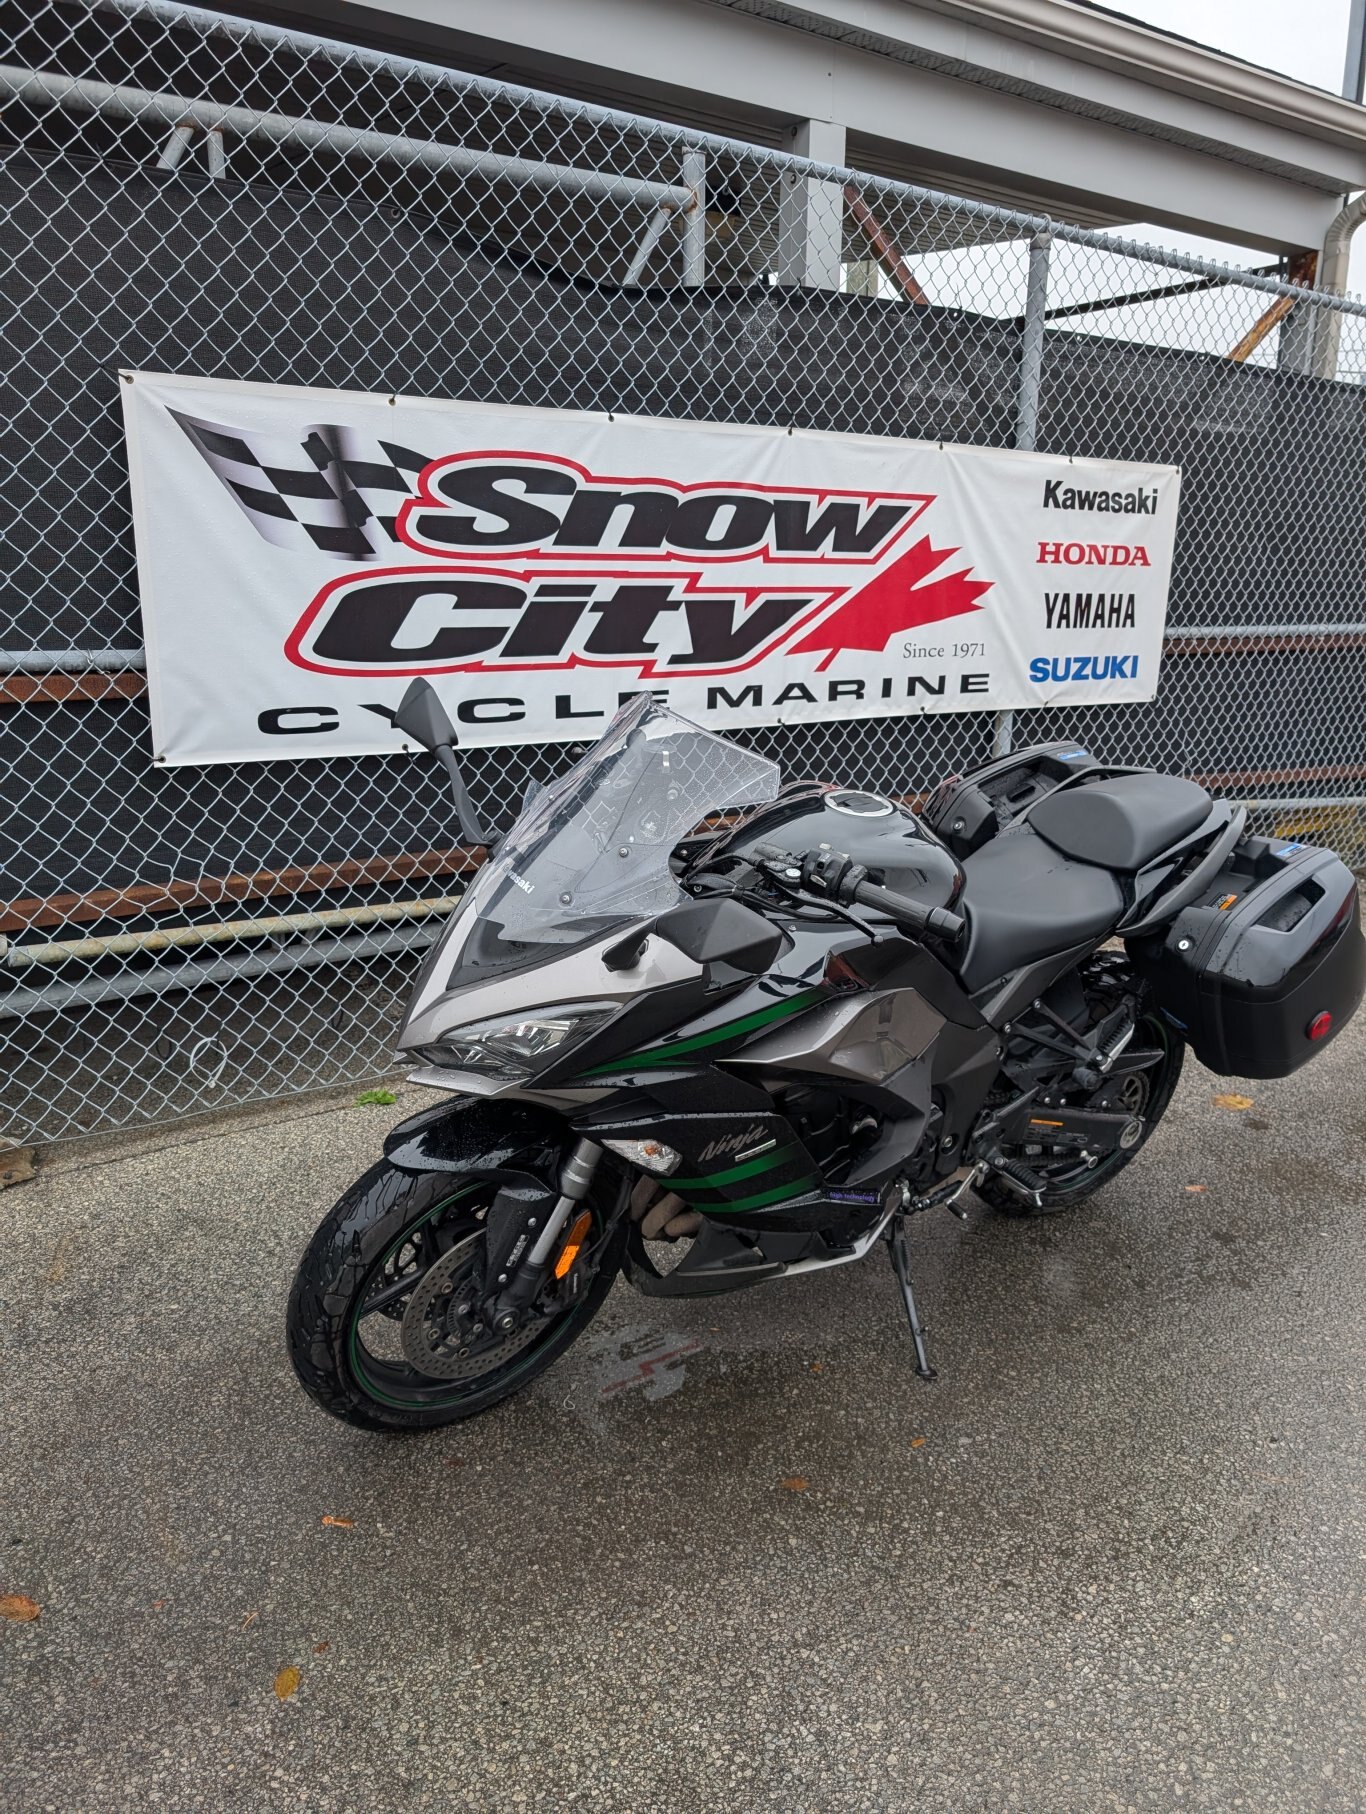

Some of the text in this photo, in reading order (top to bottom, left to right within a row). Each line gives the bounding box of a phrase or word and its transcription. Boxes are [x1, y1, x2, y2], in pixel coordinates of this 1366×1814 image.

[415, 465, 912, 553] Snow
[1043, 479, 1158, 515] Kawasaki
[1036, 541, 1151, 568] HONDA
[312, 580, 813, 666] City
[1044, 592, 1135, 629] YAMAHA
[903, 642, 985, 658] Since 1971
[1028, 654, 1140, 684] SUZUKI
[706, 673, 990, 710] MARINE
[698, 1123, 769, 1162] Ninja
